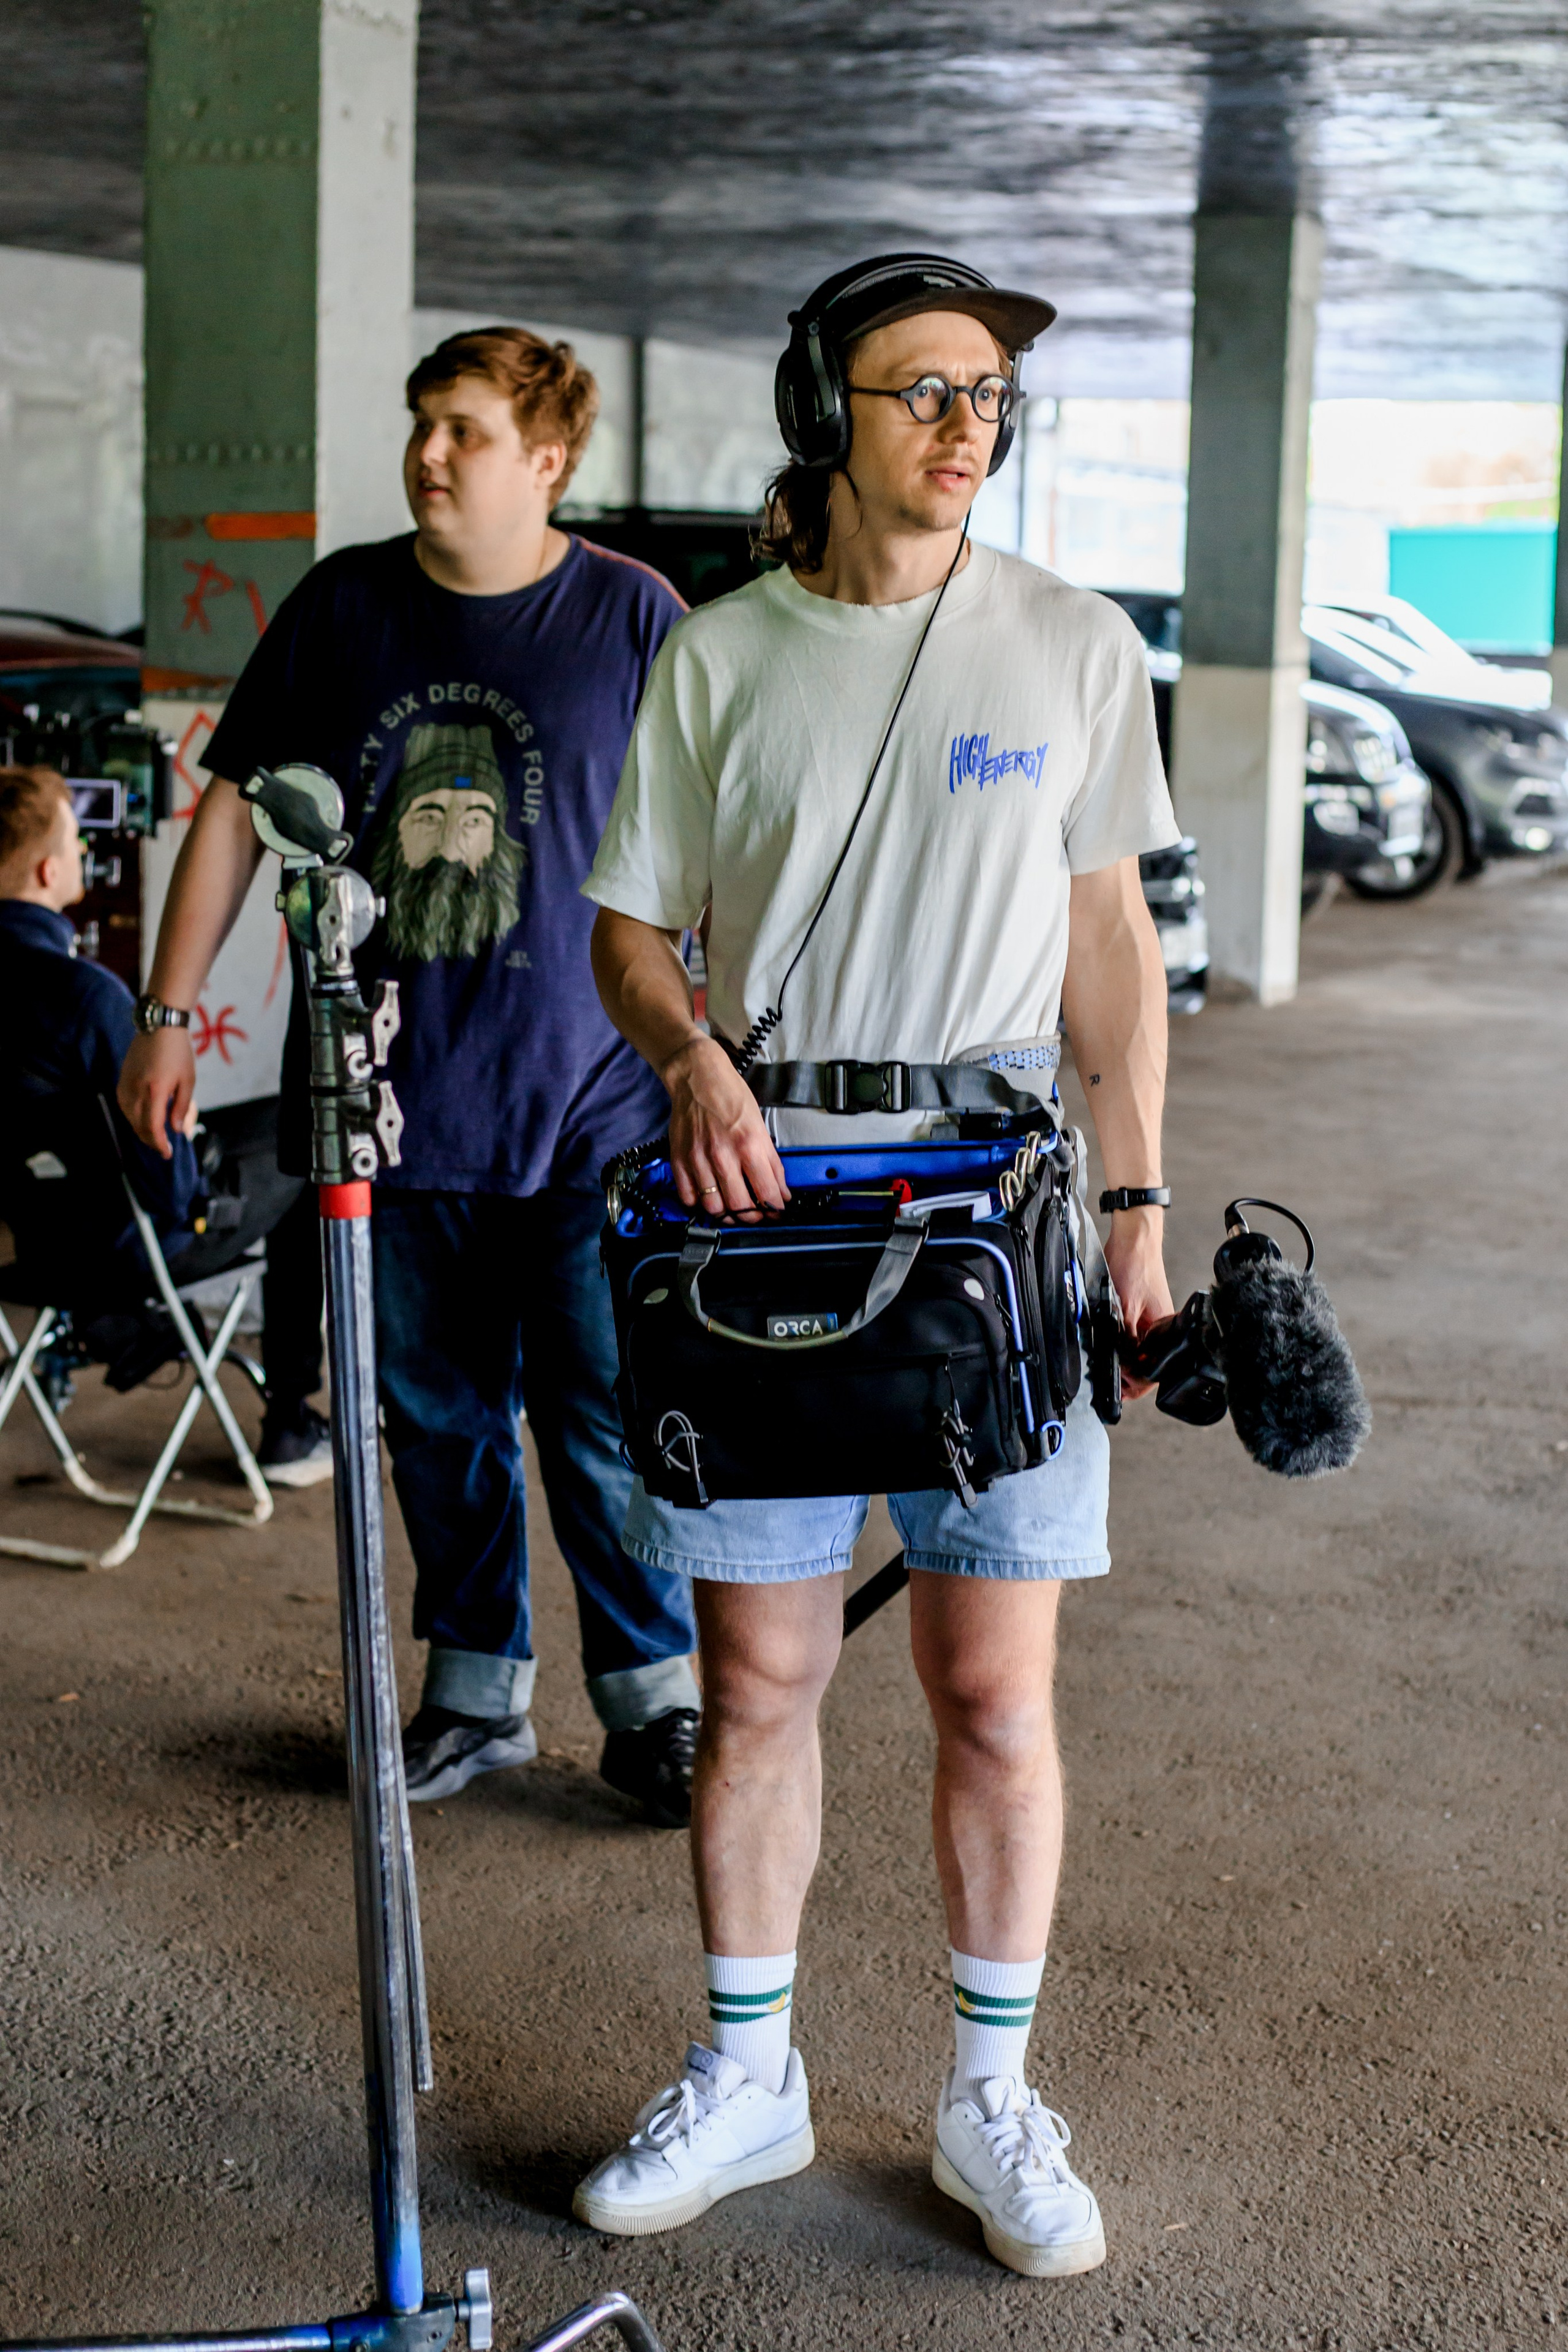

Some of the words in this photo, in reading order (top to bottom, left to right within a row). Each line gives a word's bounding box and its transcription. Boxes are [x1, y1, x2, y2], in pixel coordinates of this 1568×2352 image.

[380, 692, 421, 729] SIX
[428, 682, 534, 742] DEGREES
[520, 750, 545, 826] FOUR
[949, 733, 990, 794] HIGH
[978, 742, 1049, 791] ENERGY
[774, 1319, 823, 1338] ORCA
